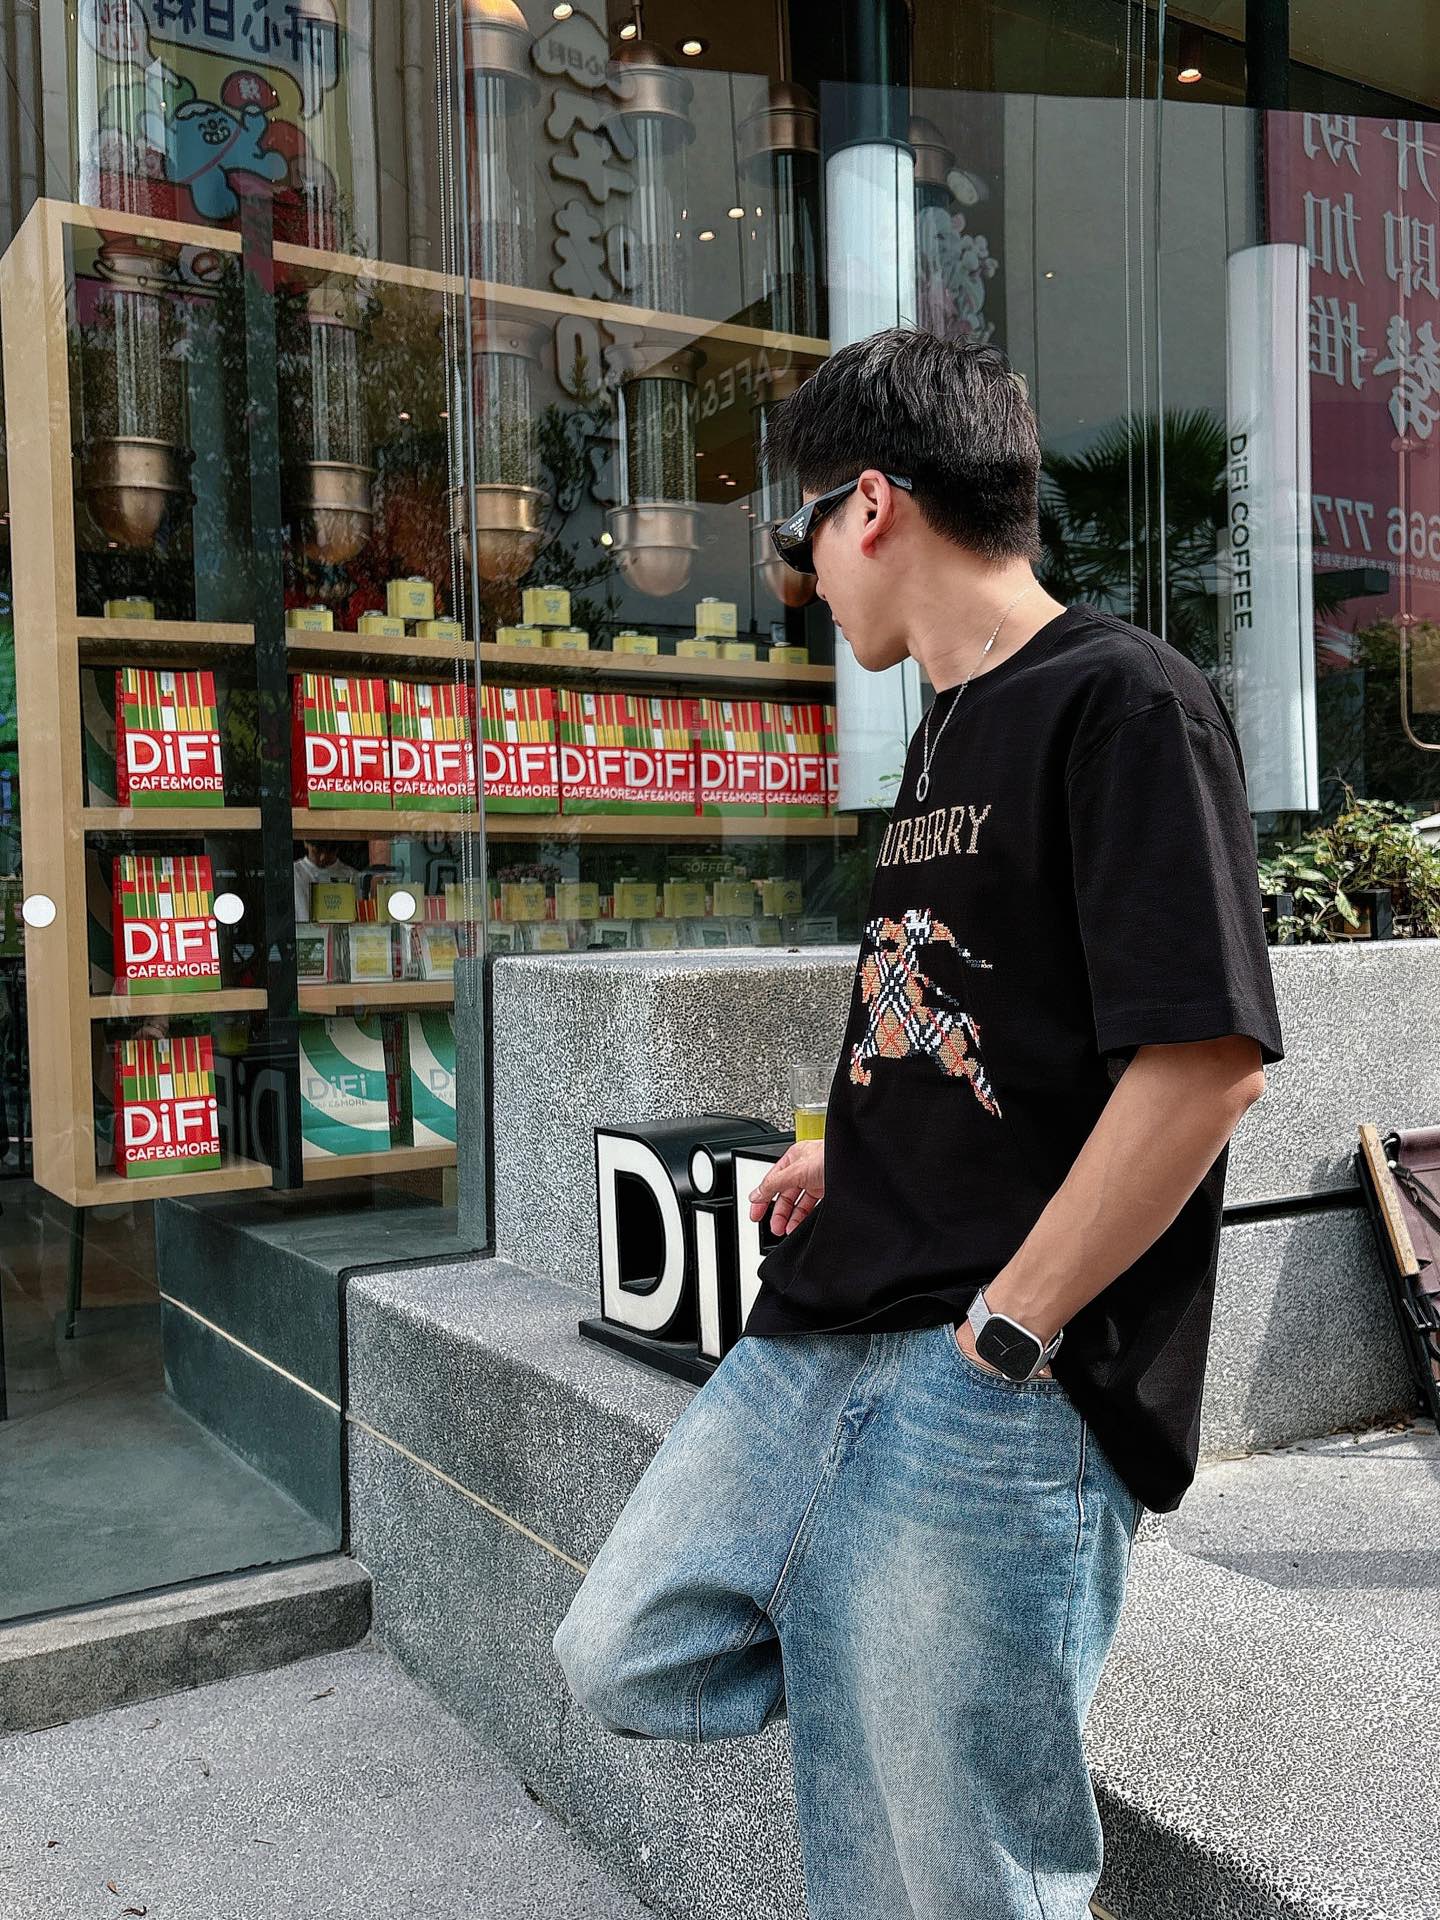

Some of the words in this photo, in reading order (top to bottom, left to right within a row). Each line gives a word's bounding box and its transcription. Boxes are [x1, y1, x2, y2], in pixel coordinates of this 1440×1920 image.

[1230, 434, 1249, 493] DiFi
[1232, 502, 1252, 631] COFFEE
[126, 733, 223, 775] DiFi
[305, 736, 391, 778] DiFi
[392, 740, 476, 782] DiFi
[483, 744, 559, 784] DiFi
[561, 745, 631, 786] DiFi
[629, 750, 695, 789] DiFi
[701, 752, 764, 791] DiFi
[765, 754, 826, 792] DiFi
[129, 775, 224, 790] CAFE&MORE
[307, 777, 391, 792] CAFE&MORE
[484, 783, 559, 798] CAFE&MORE
[876, 804, 992, 868] URBERRY
[123, 918, 220, 963] DiFi
[126, 962, 221, 978] CAFE&MORE
[307, 1072, 367, 1100] DiFi
[123, 1098, 219, 1147] DiFi
[125, 1141, 220, 1161] CAFE&MORE
